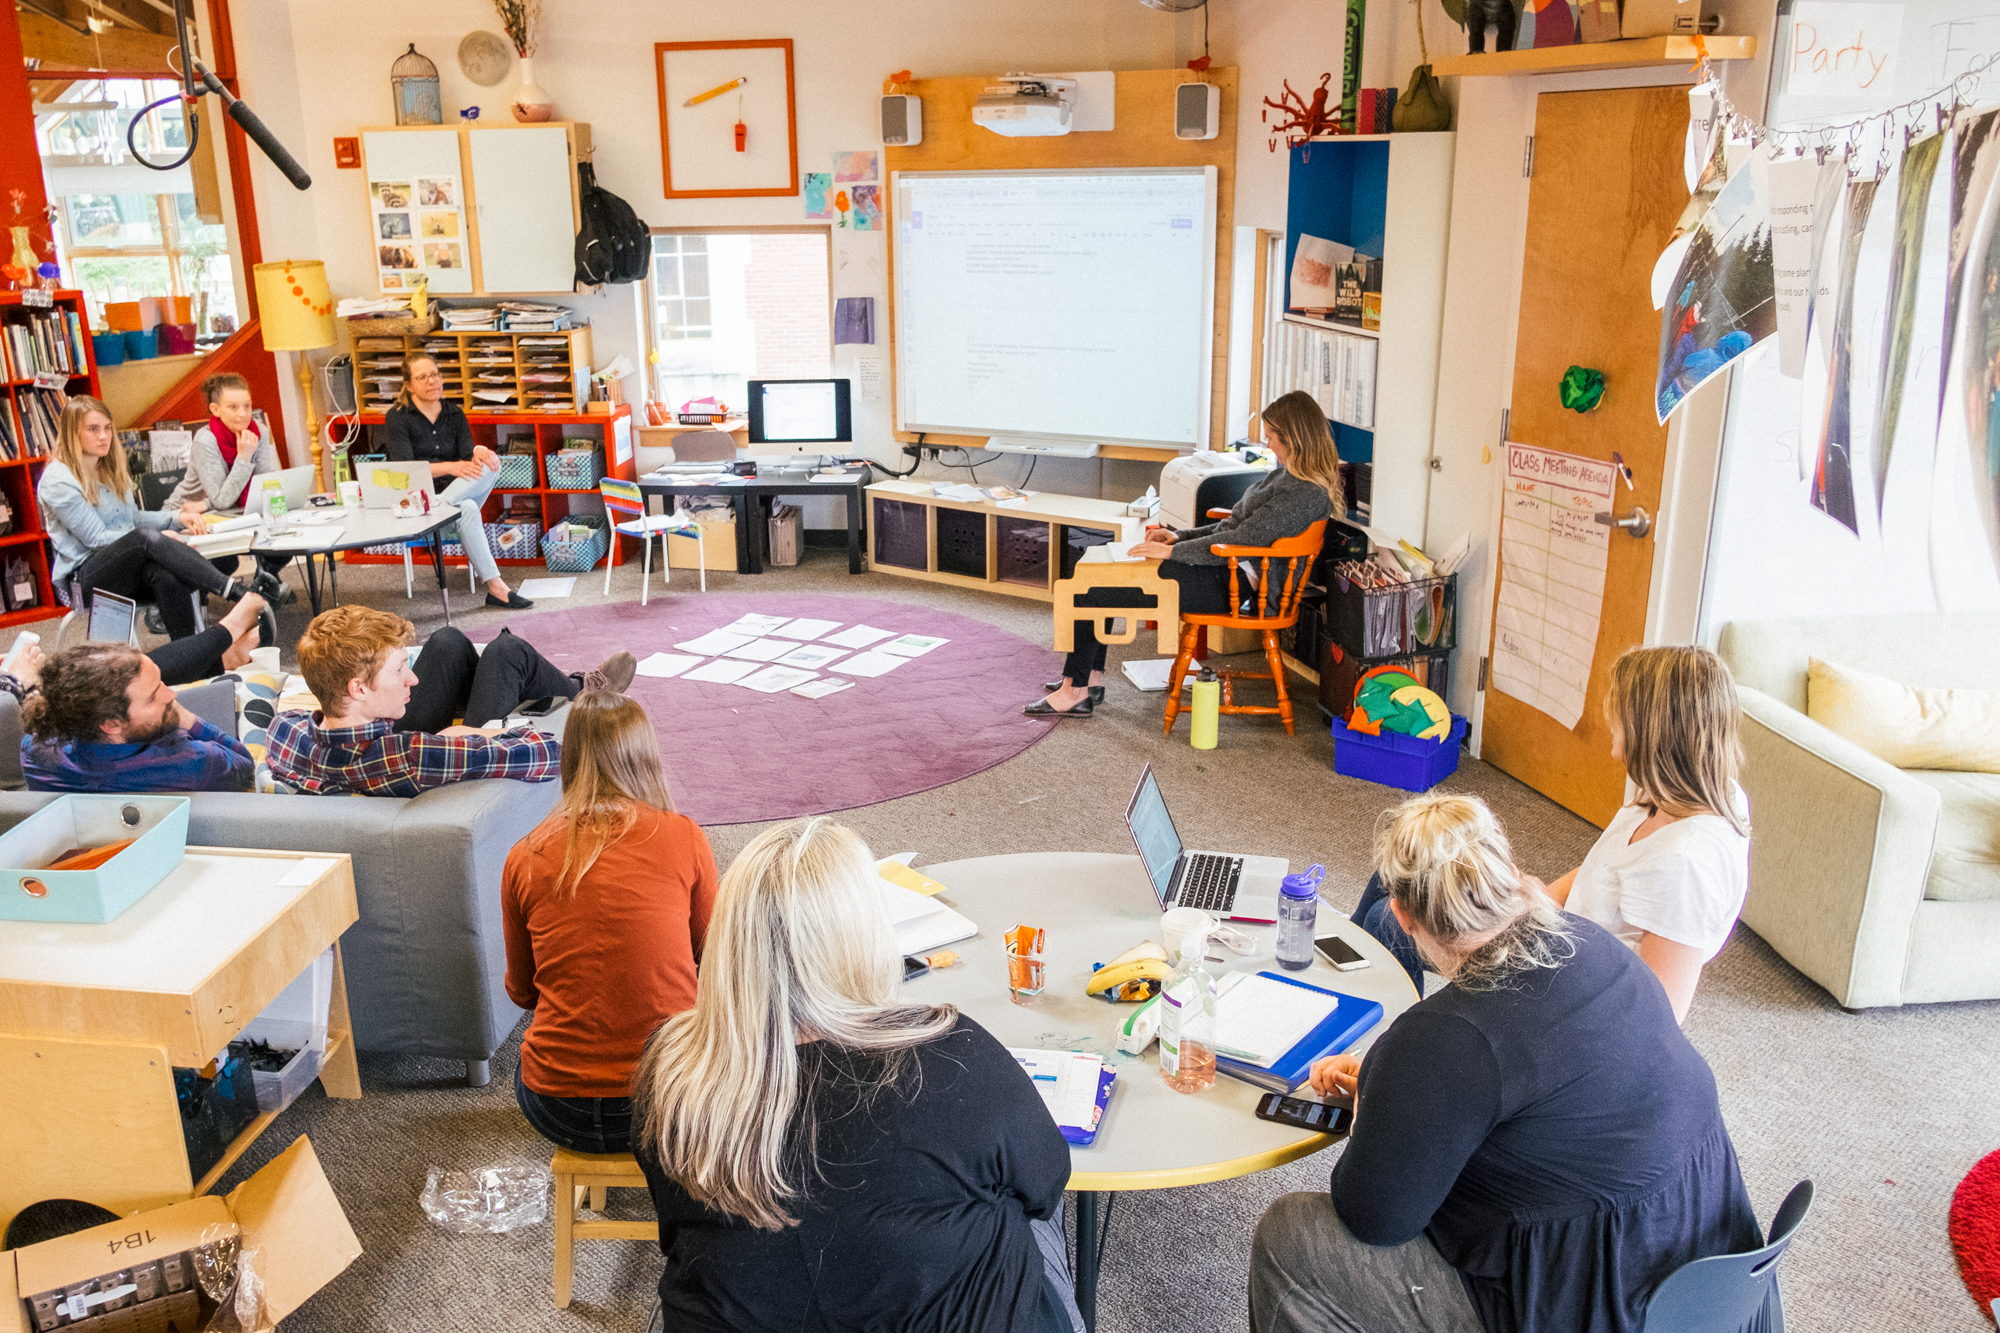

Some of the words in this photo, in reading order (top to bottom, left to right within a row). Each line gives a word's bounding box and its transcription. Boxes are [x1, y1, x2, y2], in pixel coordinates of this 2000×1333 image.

[1793, 23, 1888, 89] Party
[1342, 280, 1358, 289] THE
[1339, 288, 1362, 298] WILD
[1336, 296, 1363, 307] ROBOT
[1512, 451, 1540, 473] CLASS
[1542, 456, 1578, 477] MEETING
[1578, 466, 1609, 486] AGENDA
[1516, 481, 1536, 493] NAME
[1573, 495, 1593, 508] TOPIC
[107, 1229, 157, 1255] 1B4
